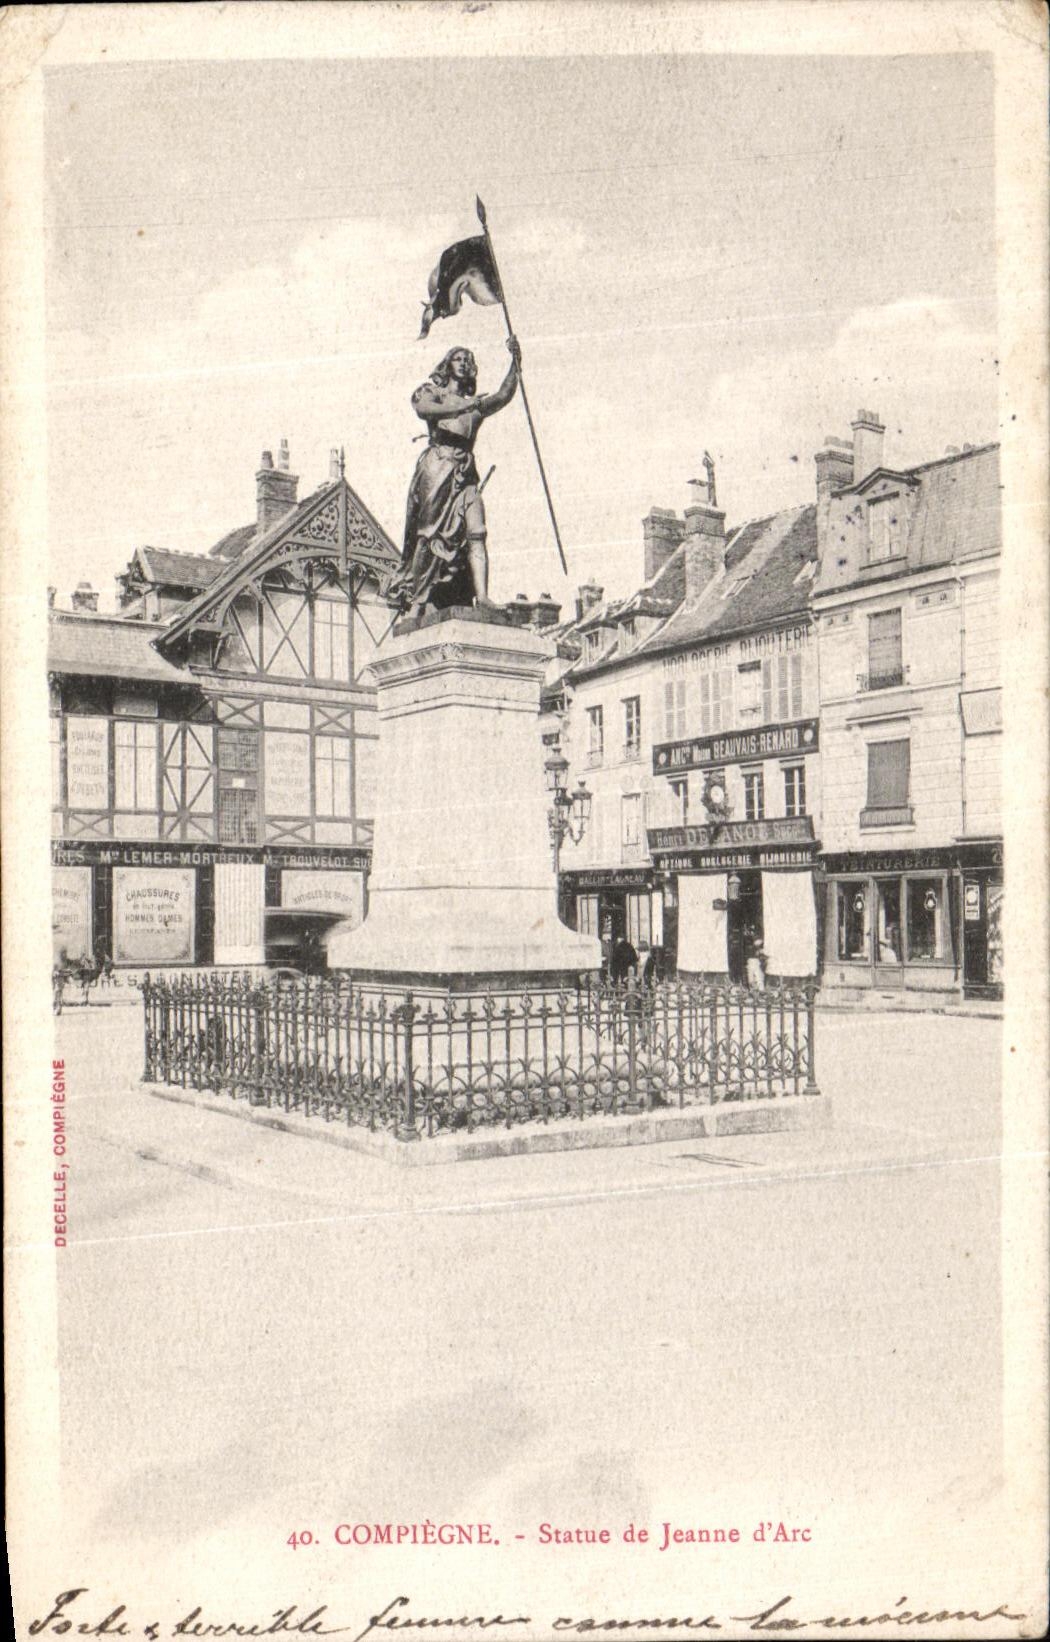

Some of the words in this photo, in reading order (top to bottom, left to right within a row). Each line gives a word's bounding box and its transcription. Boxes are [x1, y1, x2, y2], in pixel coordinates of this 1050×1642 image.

[740, 624, 814, 657] BIJOUTERIE
[713, 728, 799, 760] BEAUVAIS-RENARD
[760, 850, 812, 866] BIJOUTERIE
[841, 856, 940, 872] TEINTURERIE
[126, 887, 180, 902] CHAUSSURES
[171, 1605, 351, 1637] terrible
[350, 1597, 531, 1642] femme
[552, 1616, 722, 1633] comme
